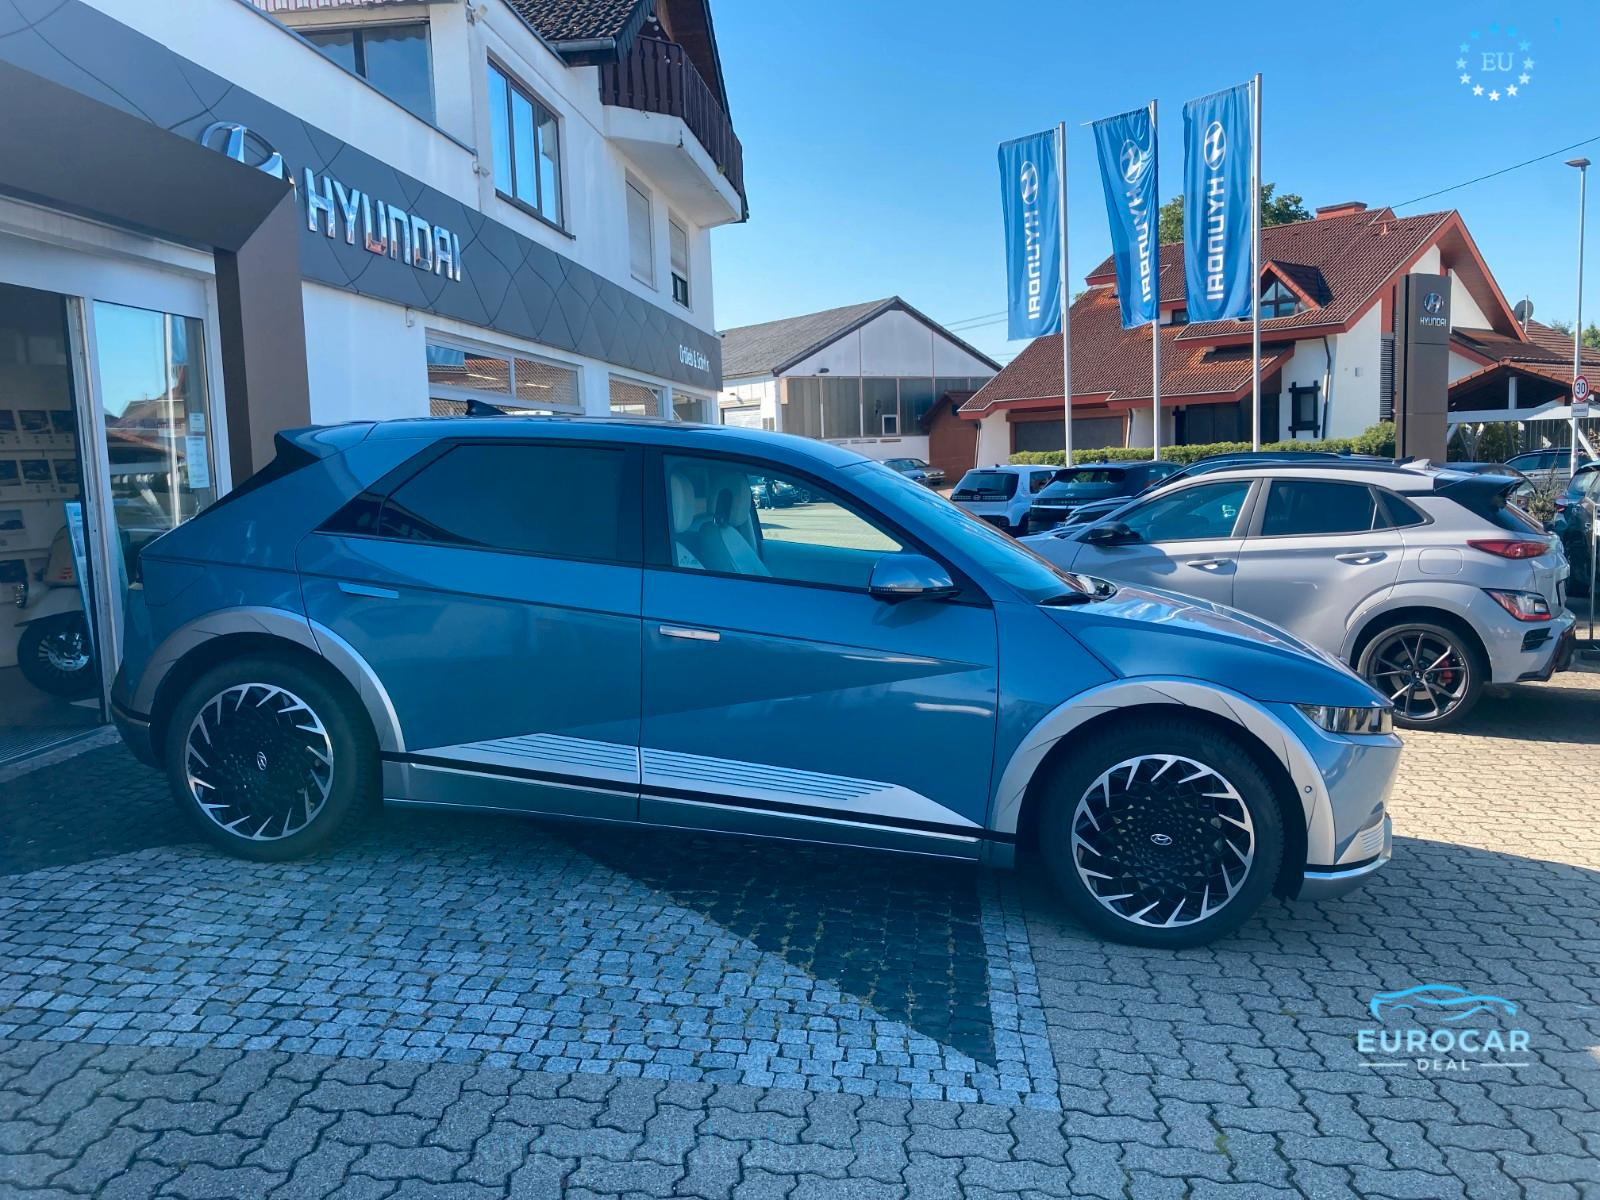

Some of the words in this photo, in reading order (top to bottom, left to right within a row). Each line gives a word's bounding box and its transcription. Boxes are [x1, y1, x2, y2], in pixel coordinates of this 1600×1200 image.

[303, 167, 461, 282] HYUNDAI
[1420, 316, 1447, 327] HYUNDAI
[1576, 382, 1586, 395] 30
